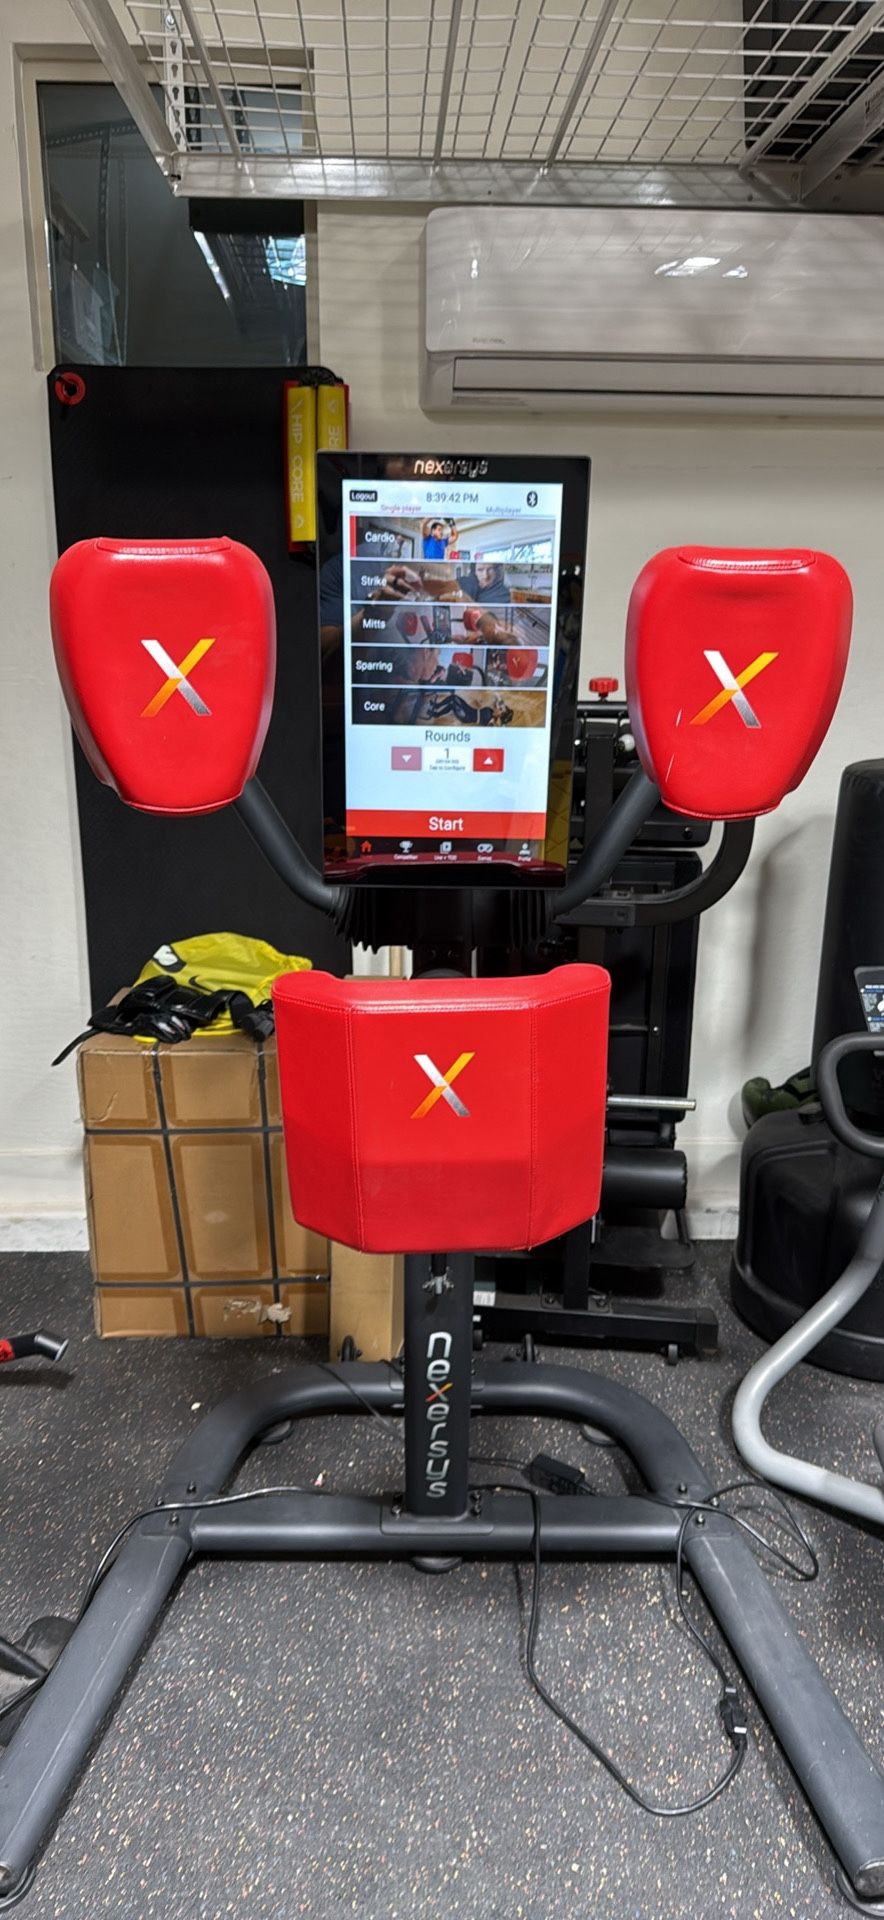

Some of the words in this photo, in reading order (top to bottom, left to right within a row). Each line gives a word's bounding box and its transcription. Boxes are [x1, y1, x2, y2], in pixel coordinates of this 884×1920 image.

[291, 415, 303, 444] HIP
[413, 459, 489, 478] nexersys
[291, 455, 304, 503] CORE
[351, 491, 376, 502] Logout
[425, 492, 461, 503] 8:39:42
[463, 493, 479, 504] PM
[365, 531, 395, 543] Cardio
[361, 575, 387, 587] Strike
[362, 618, 386, 630] Mitts
[355, 660, 393, 672] Sparring
[364, 701, 386, 712] Core
[425, 730, 471, 743] Rounds
[444, 748, 450, 759] 1
[428, 816, 464, 831] Start
[425, 1331, 453, 1498] nexersys
